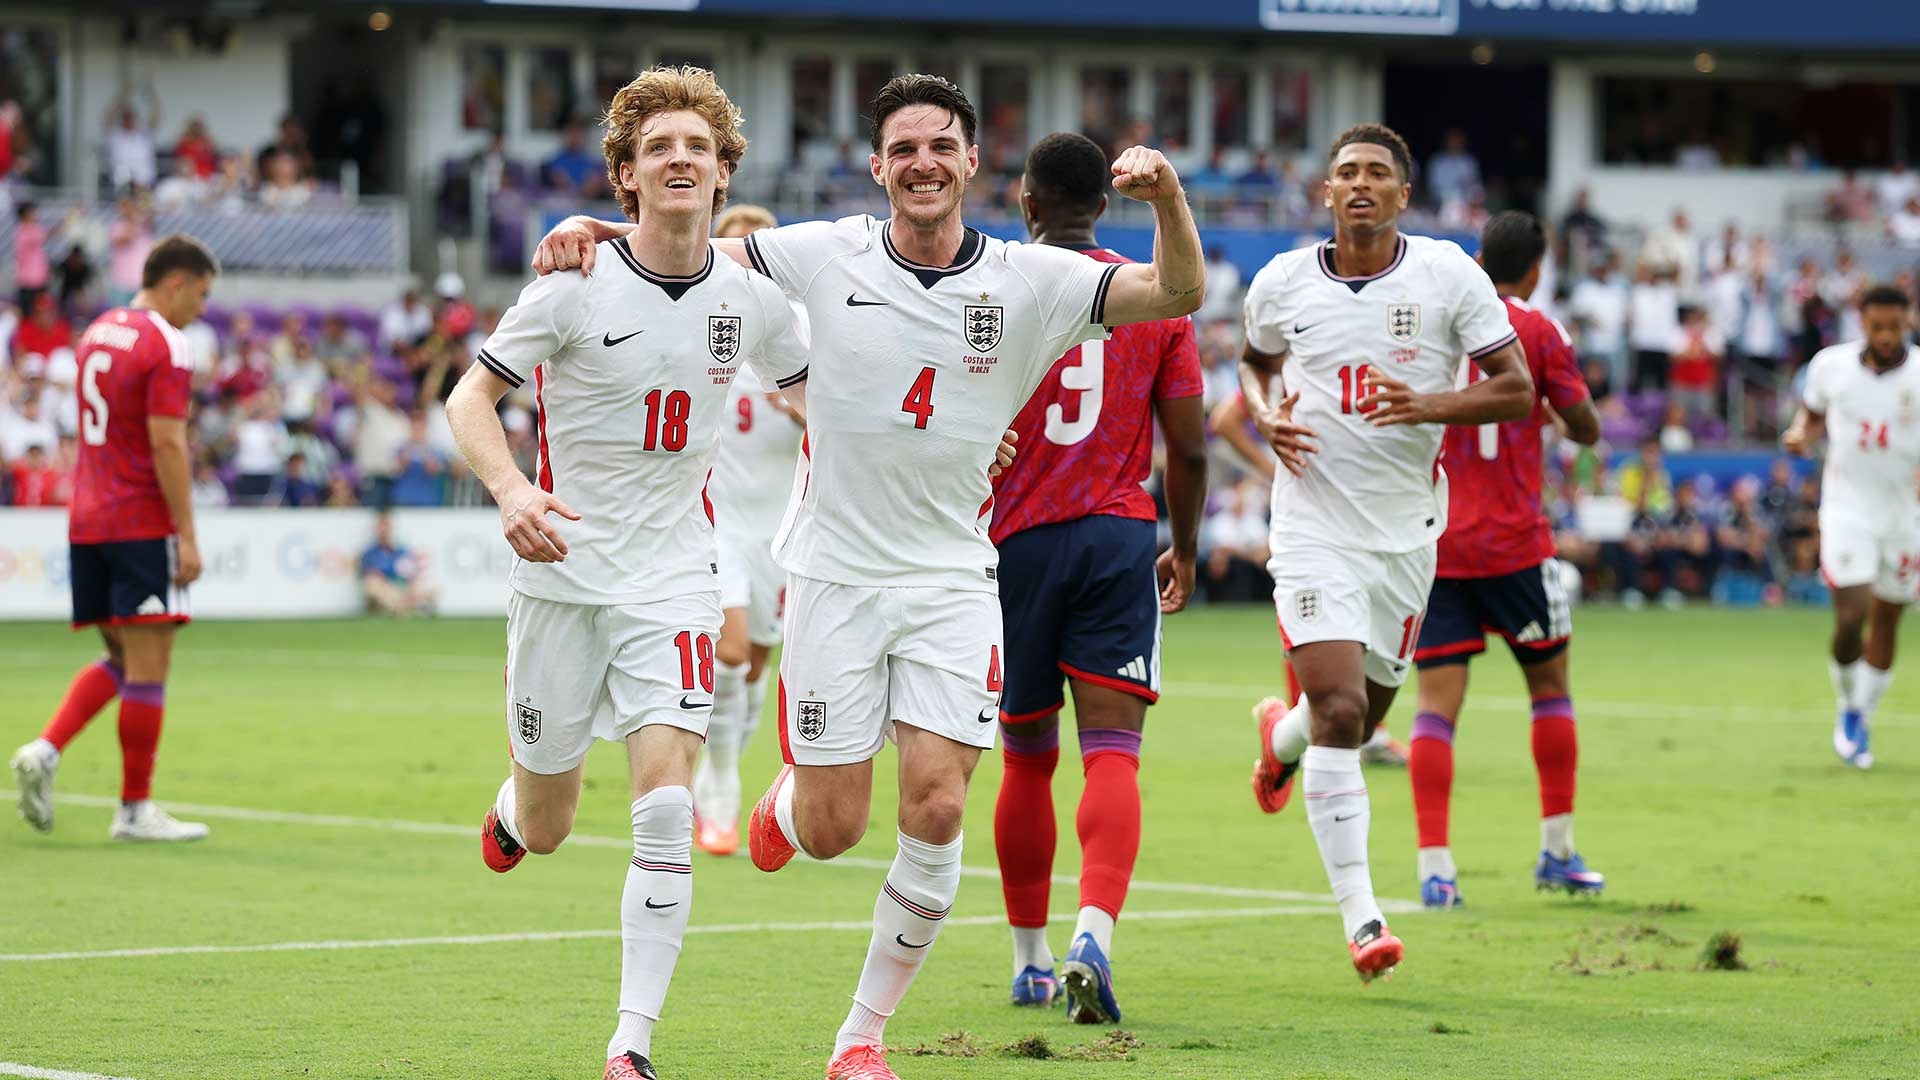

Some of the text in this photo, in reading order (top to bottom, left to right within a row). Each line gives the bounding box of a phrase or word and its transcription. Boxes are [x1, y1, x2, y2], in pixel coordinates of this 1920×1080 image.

[707, 367, 725, 376] COSTA
[962, 355, 998, 365] COSTA RICA
[81, 349, 113, 446] 5
[642, 388, 692, 453] 18
[737, 395, 753, 434] 9
[901, 366, 937, 430] 4
[1857, 417, 1890, 454] 24
[673, 630, 715, 695] 18
[986, 644, 1003, 708] 4
